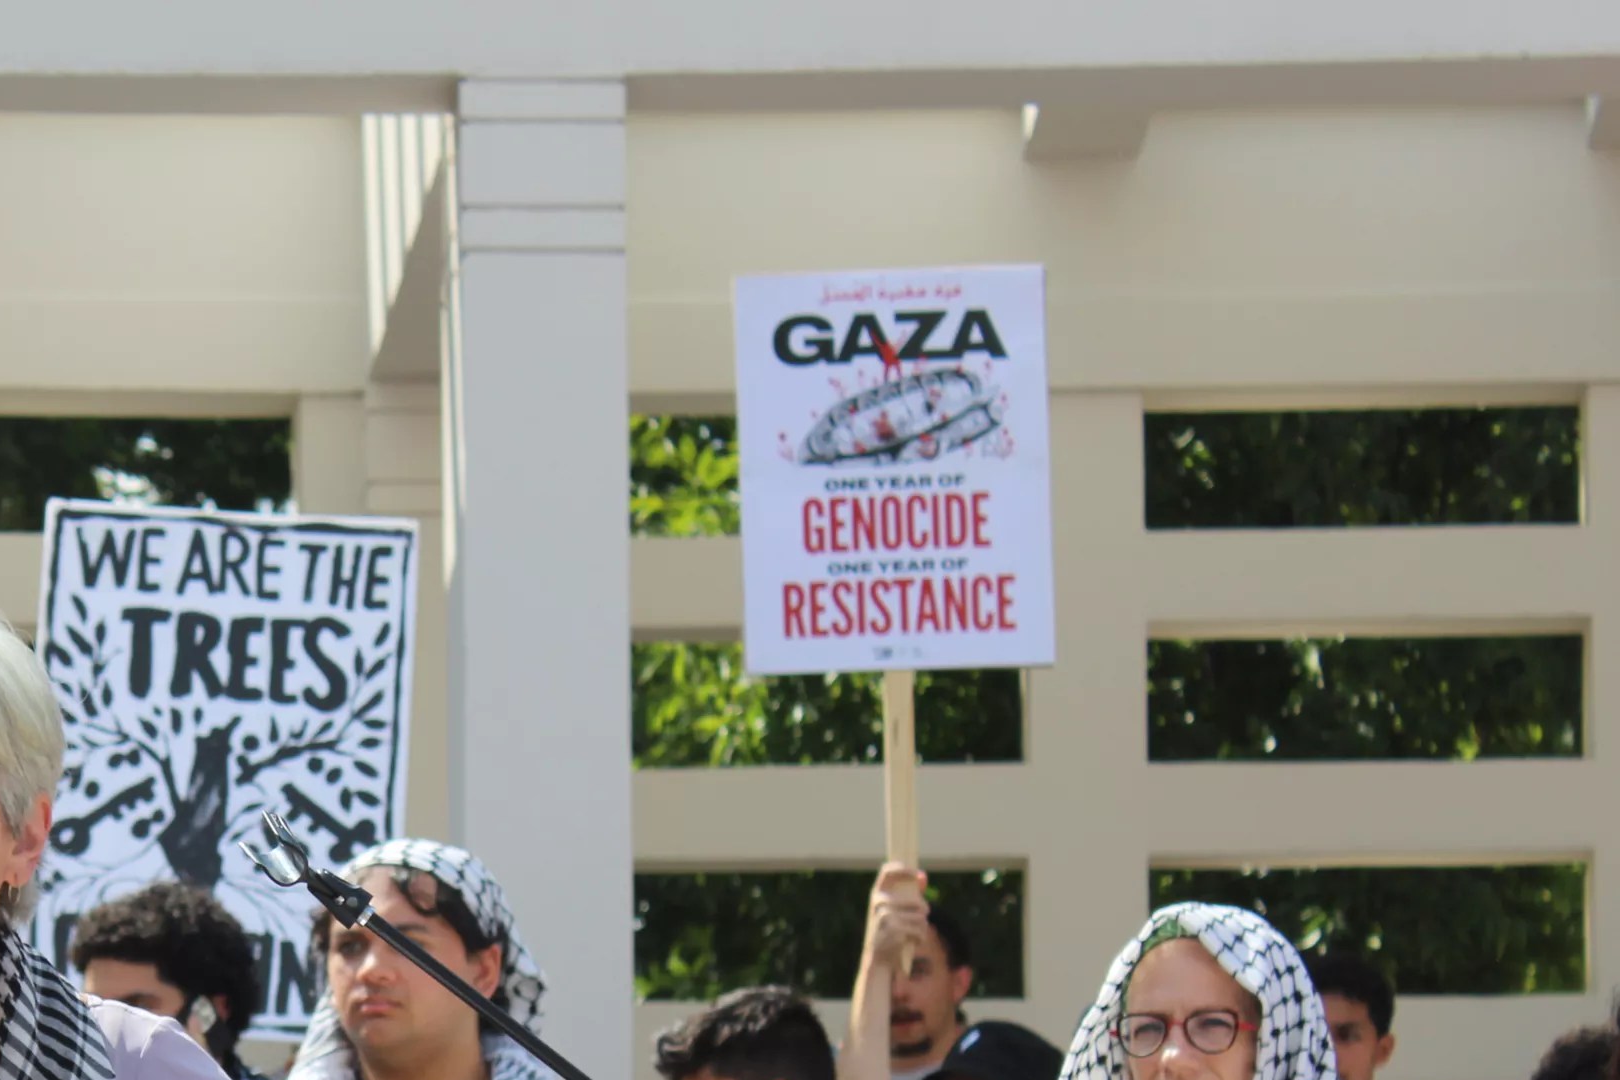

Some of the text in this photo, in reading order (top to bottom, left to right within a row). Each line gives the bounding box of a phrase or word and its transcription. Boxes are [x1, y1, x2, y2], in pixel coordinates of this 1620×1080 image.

[772, 309, 1009, 366] GAZA
[825, 474, 966, 491] ONE YEAR OF
[802, 490, 992, 554] GENOCIDE
[76, 527, 393, 611] WE ARE THE
[827, 557, 969, 576] ONE YEAR OF
[783, 574, 1018, 640] RESISTANCE
[122, 607, 352, 711] TREES
